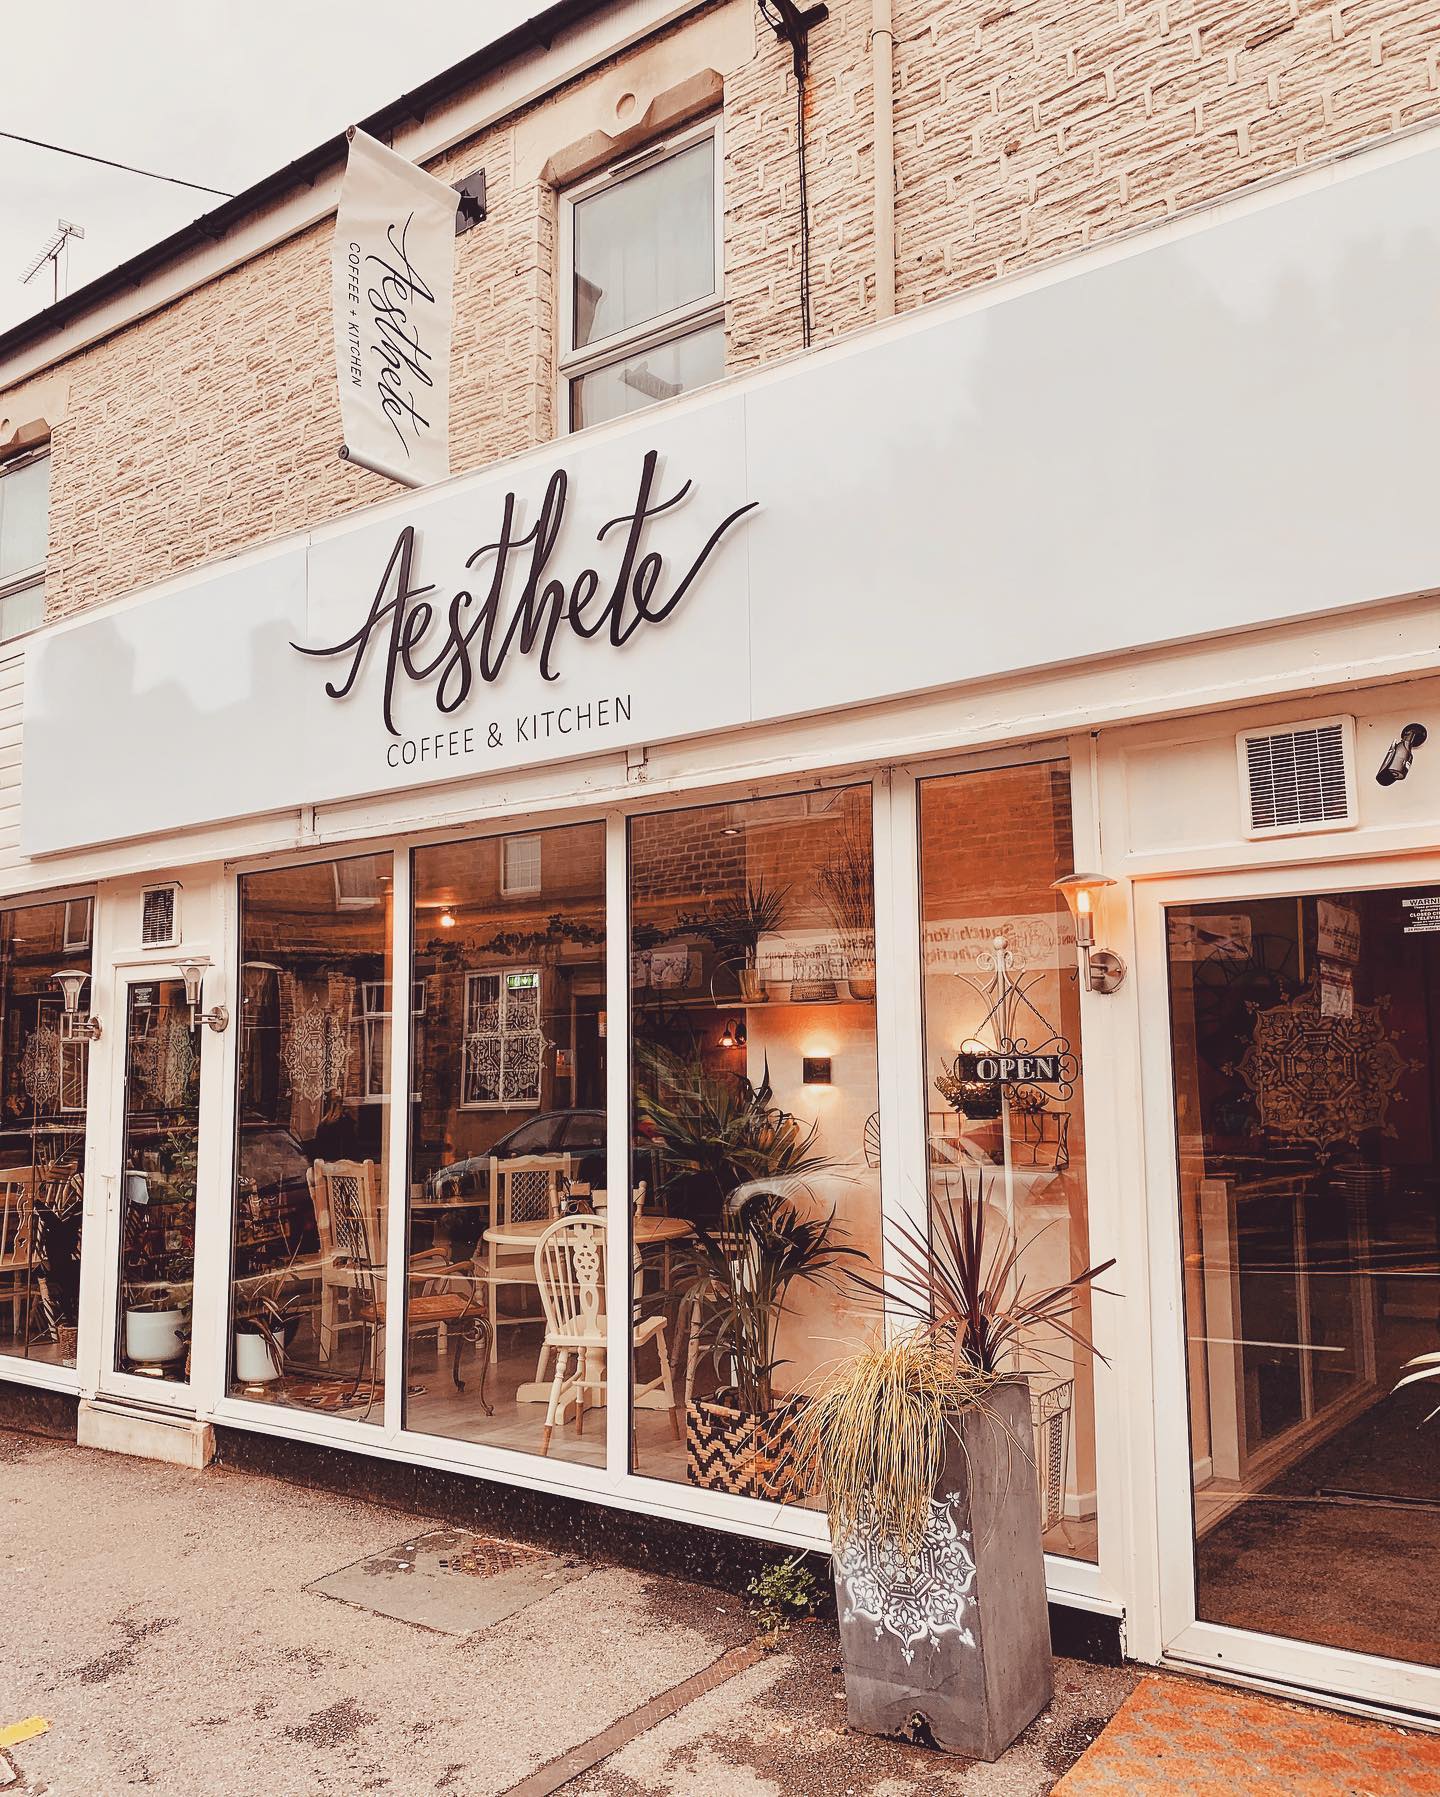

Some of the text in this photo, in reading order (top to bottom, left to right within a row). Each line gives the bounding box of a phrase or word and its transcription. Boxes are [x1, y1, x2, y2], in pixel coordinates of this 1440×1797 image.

[348, 242, 361, 304] COFFEE
[348, 321, 362, 387] KITCHEN
[365, 211, 435, 458] Aesthete
[289, 450, 759, 736] Aesthete
[387, 695, 631, 767] COFFEE & KITCHEN
[1410, 898, 1440, 906] WARNI
[976, 1057, 1053, 1080] OPEN
